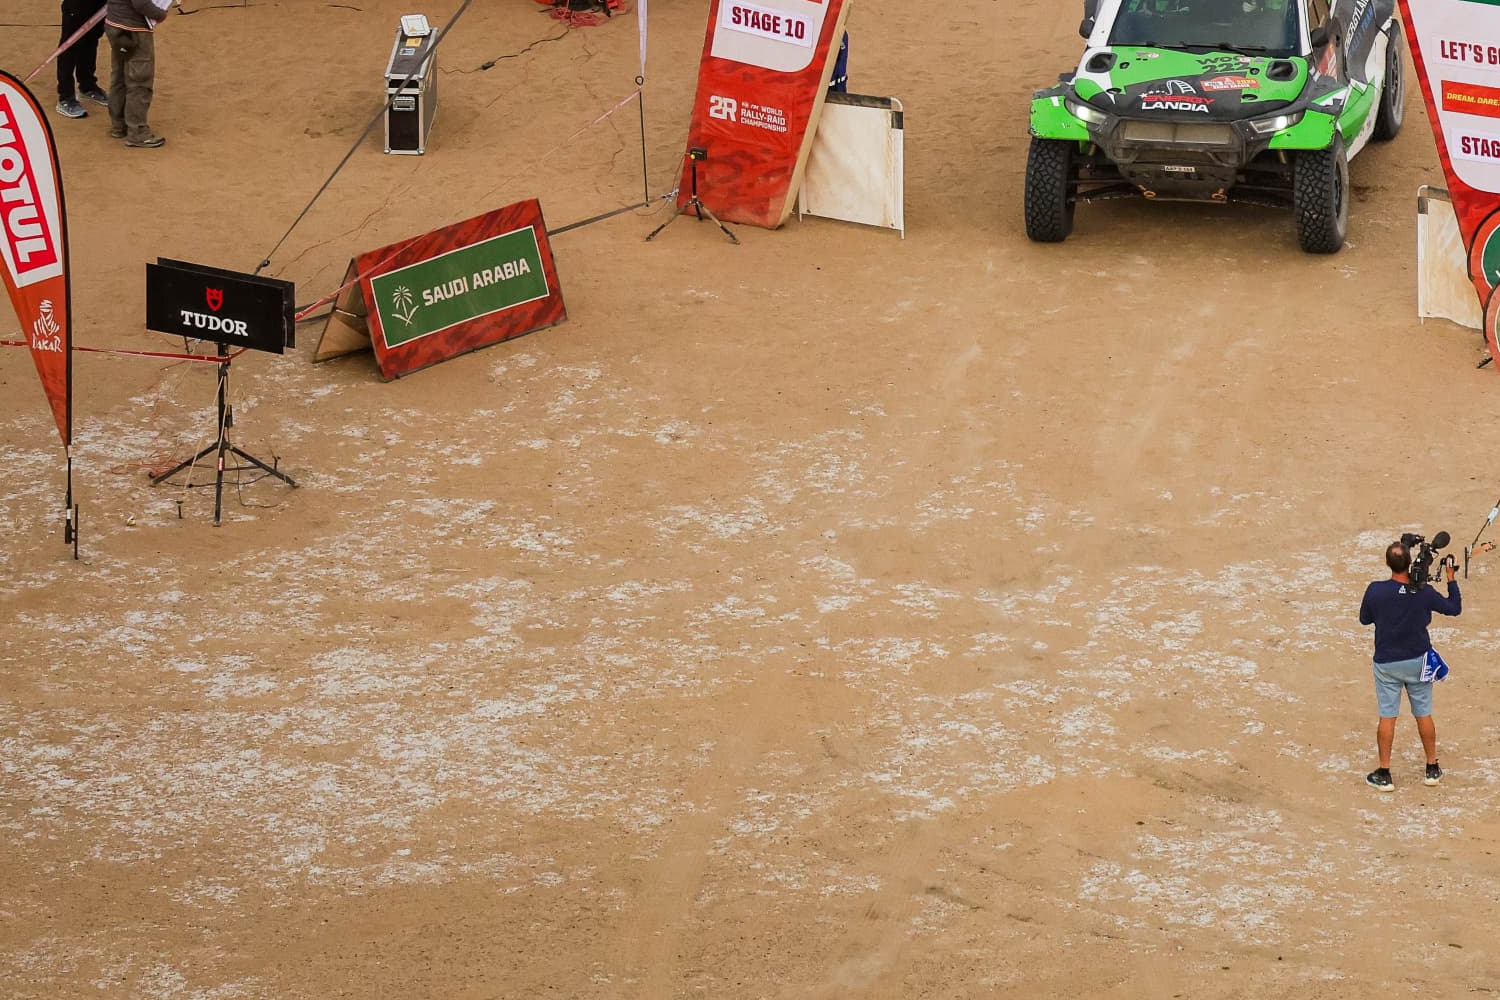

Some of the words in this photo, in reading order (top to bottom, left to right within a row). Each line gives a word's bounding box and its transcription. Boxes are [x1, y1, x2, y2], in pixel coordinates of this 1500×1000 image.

[731, 6, 782, 36] STAGE
[785, 18, 805, 40] 10
[1142, 101, 1210, 113] LANDIA
[1446, 92, 1476, 104] DREAM.
[1477, 96, 1500, 107] DARE.
[741, 108, 786, 126] RALLY-RAID
[761, 105, 783, 116] WORLD
[741, 117, 787, 133] CHAMPIONSHIP
[422, 277, 469, 307] SAUDI
[472, 258, 531, 293] ARABIA
[181, 310, 249, 337] TUDOR
[32, 334, 63, 352] DAKAR
